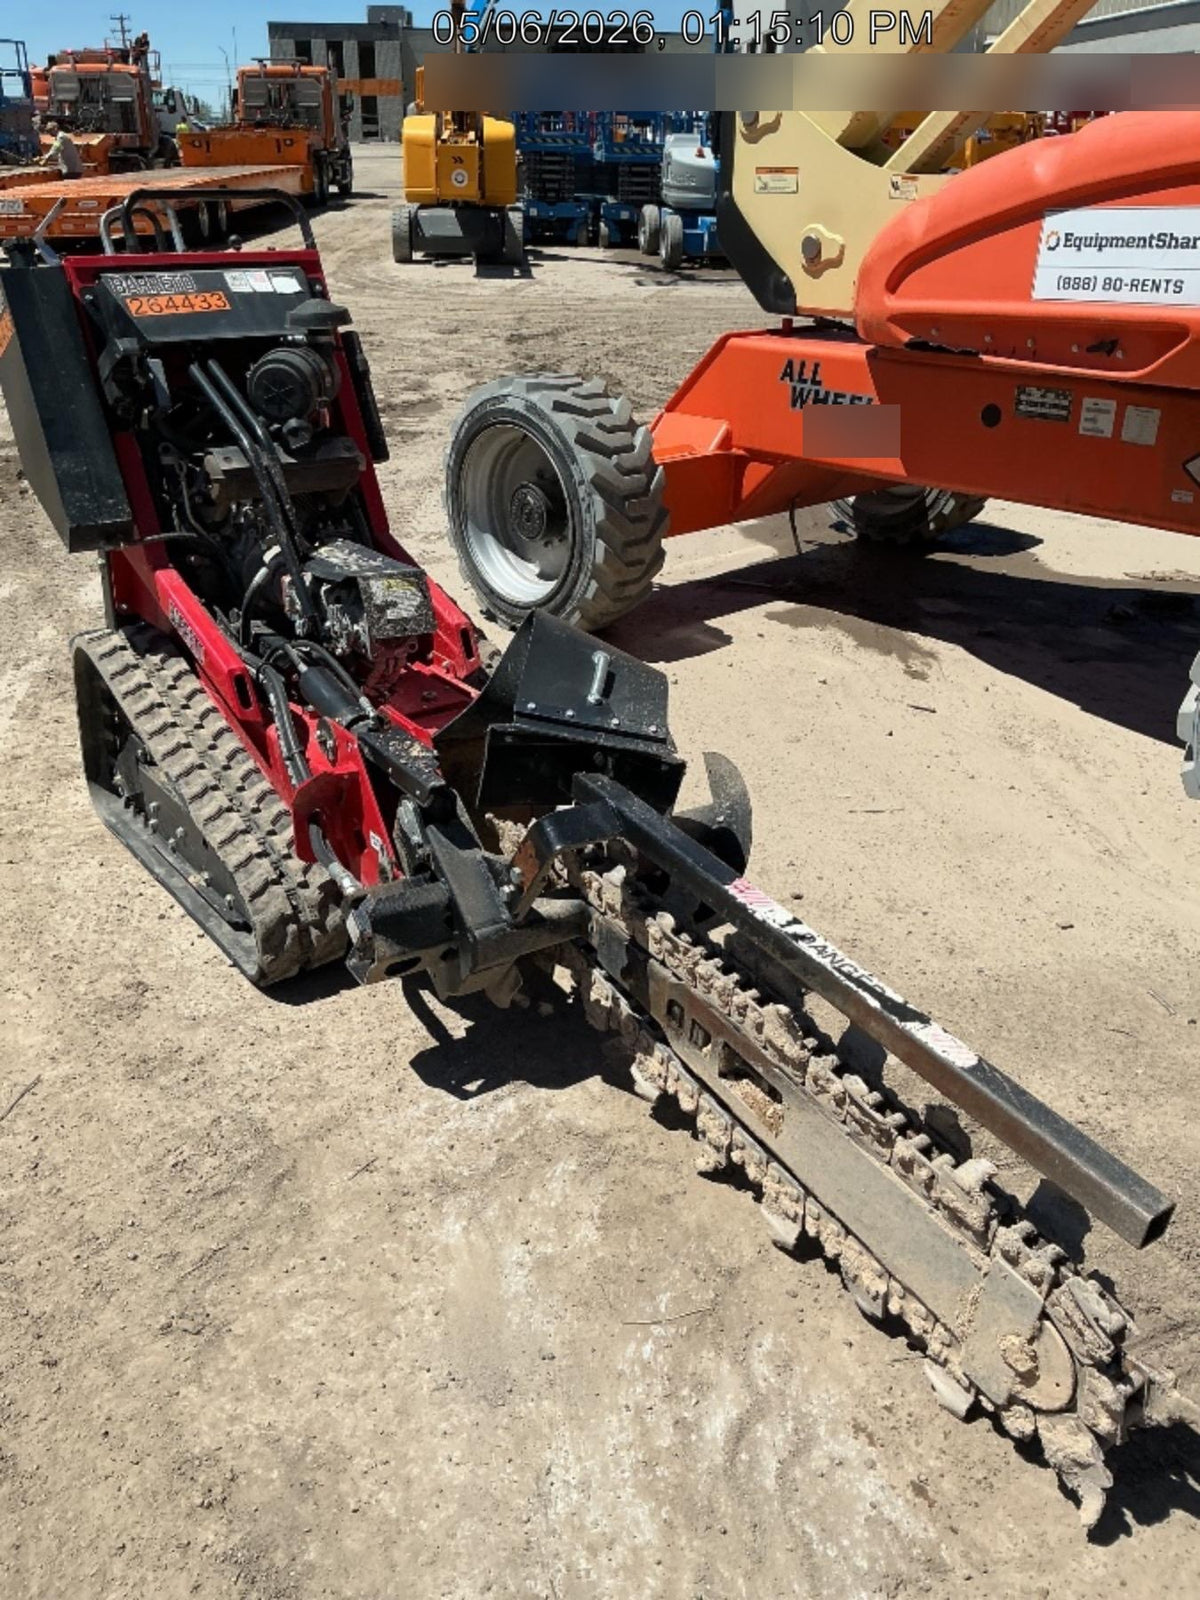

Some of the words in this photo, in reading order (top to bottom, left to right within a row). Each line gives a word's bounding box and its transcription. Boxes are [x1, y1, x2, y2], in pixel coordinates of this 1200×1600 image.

[1056, 274, 1098, 292] (888)
[1101, 276, 1185, 294] 80-RENTS
[129, 292, 228, 316] 264433
[779, 357, 823, 386] ALL
[790, 385, 874, 410] WHE
